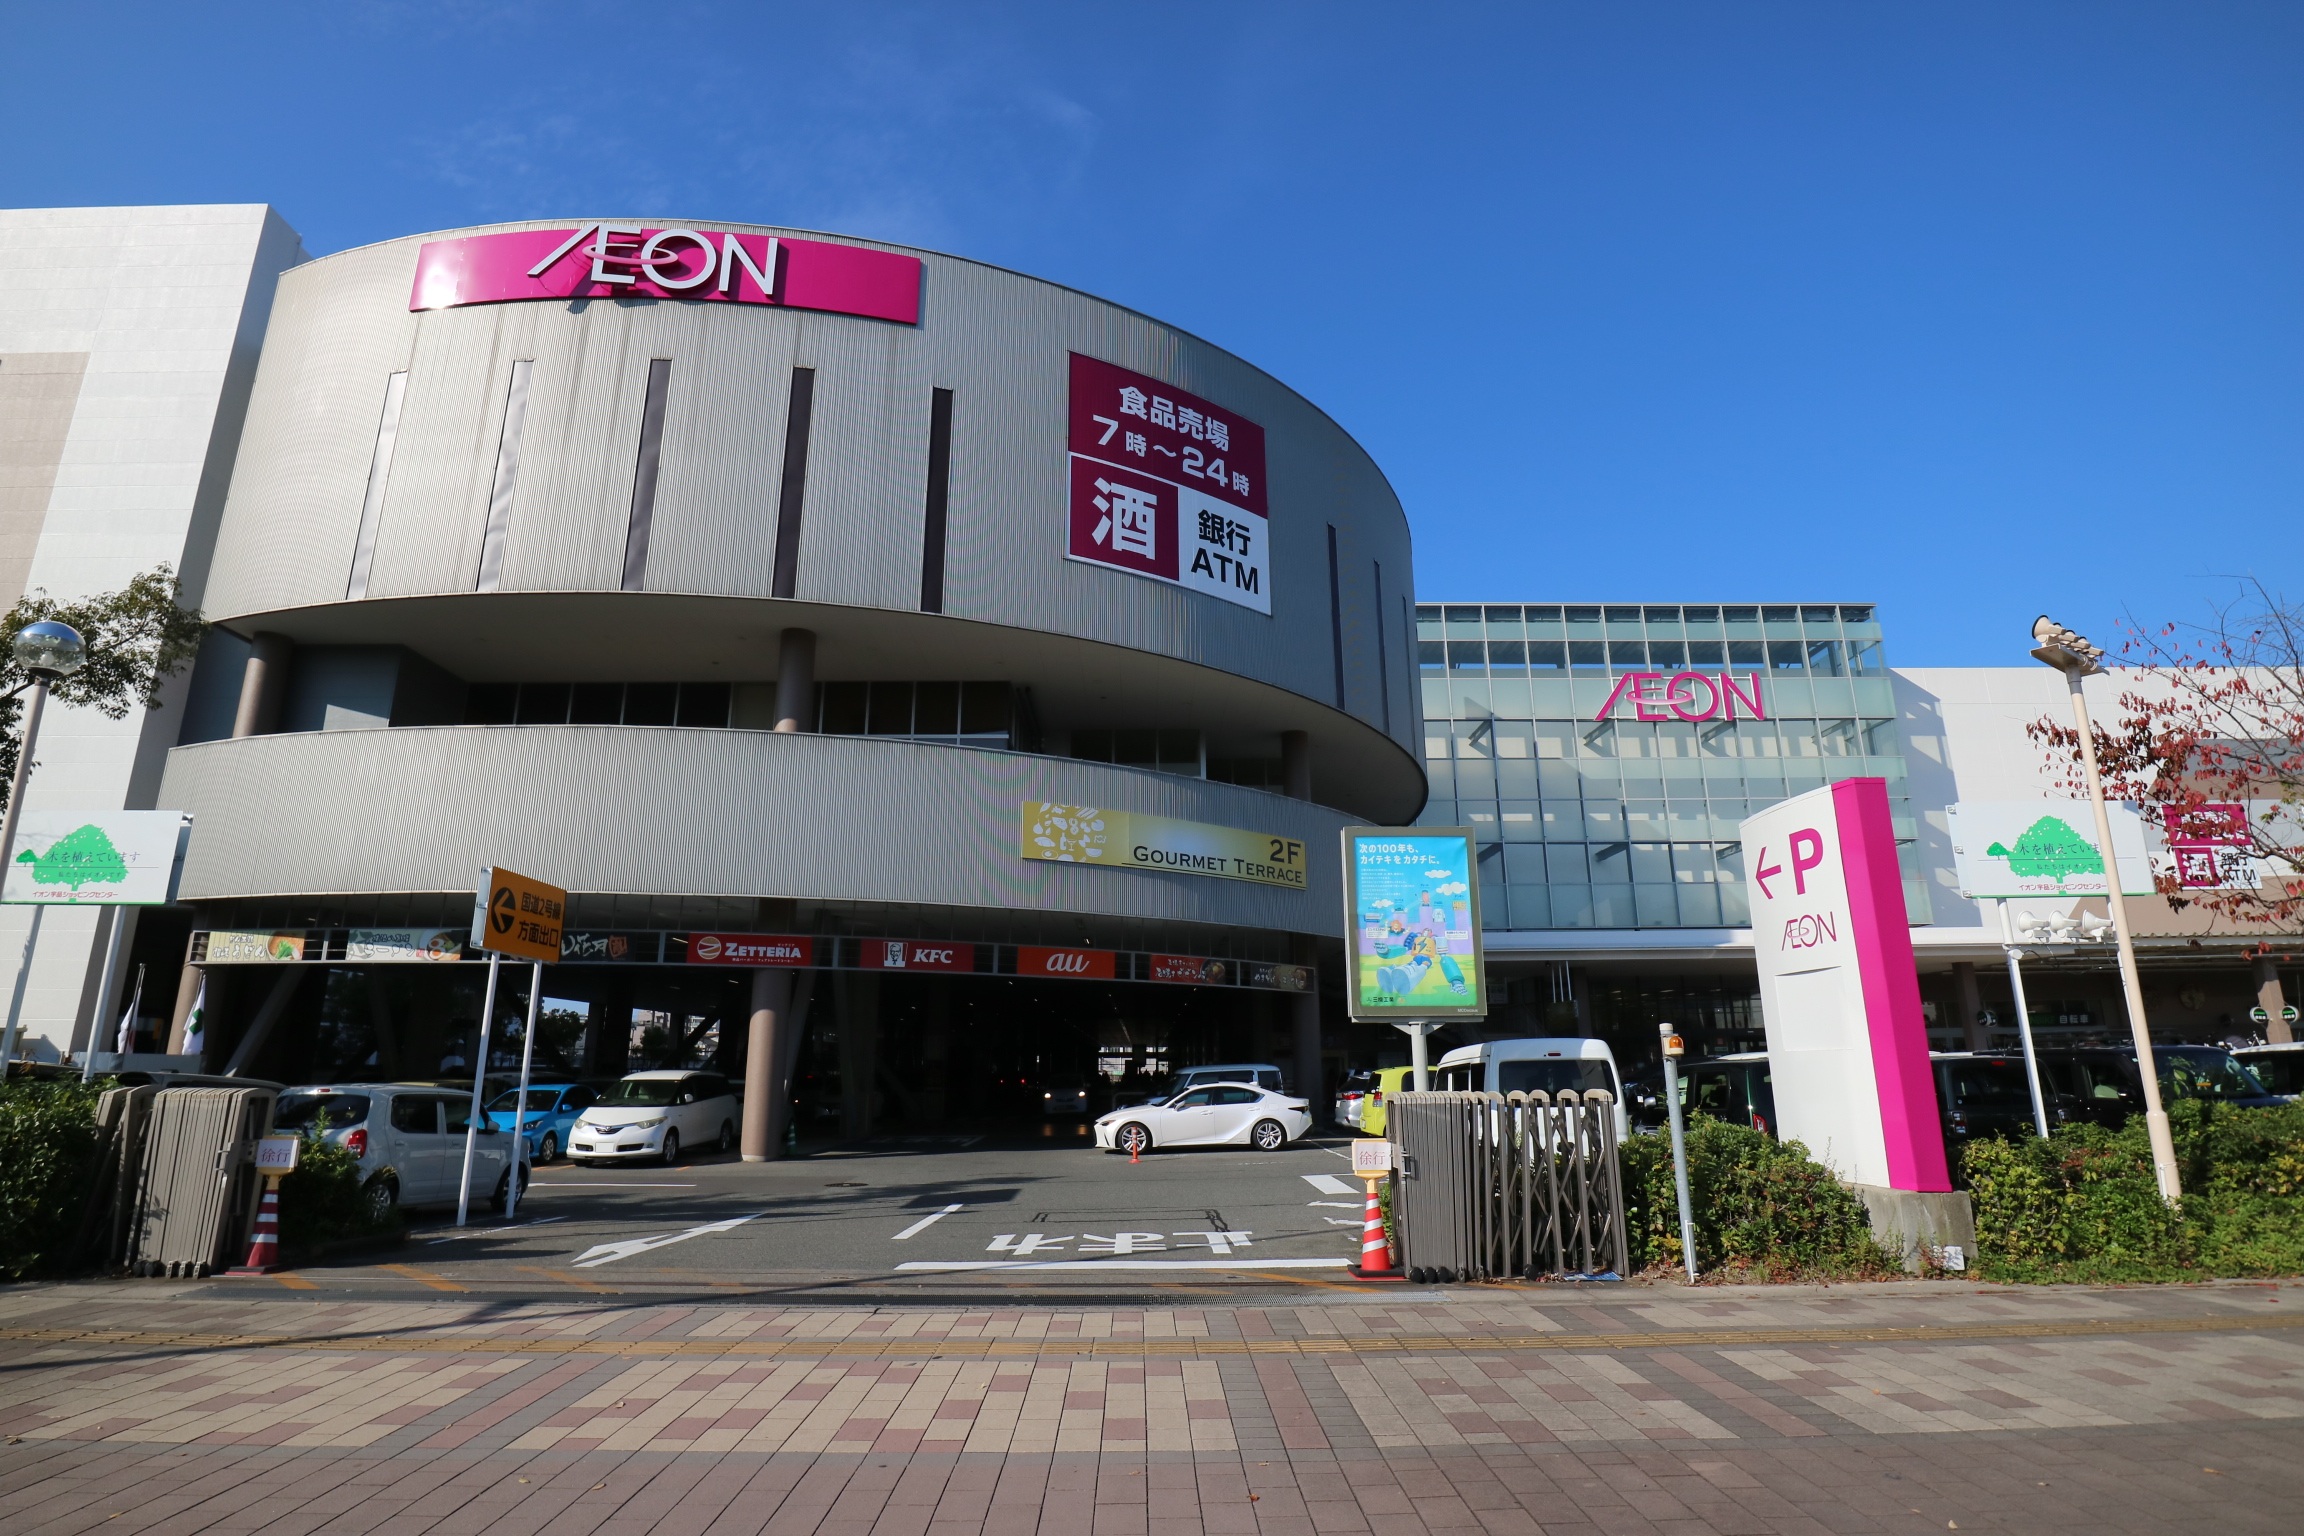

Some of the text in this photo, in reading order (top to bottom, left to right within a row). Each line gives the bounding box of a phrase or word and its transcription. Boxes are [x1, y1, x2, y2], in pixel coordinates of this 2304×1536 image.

[1118, 385, 1230, 453] 食品売場
[1091, 476, 1158, 561] 酒
[1197, 509, 1251, 557] 銀行
[1190, 547, 1259, 595] ATM
[49, 851, 141, 864] 木を植えています
[1269, 838, 1302, 866] 2F
[1359, 843, 1420, 854] 次の100年も、
[2020, 843, 2100, 855] 木を植えていま
[1788, 827, 1824, 896] P
[520, 891, 562, 921] 国道2号線
[517, 919, 559, 948] 方面出口
[724, 942, 802, 959] ZETTERIA
[913, 948, 953, 964] KFC
[1046, 953, 1090, 972] au
[2059, 1013, 2089, 1024] 自転車
[261, 1148, 290, 1163] 徐行
[1359, 1150, 1386, 1165] 徐行
